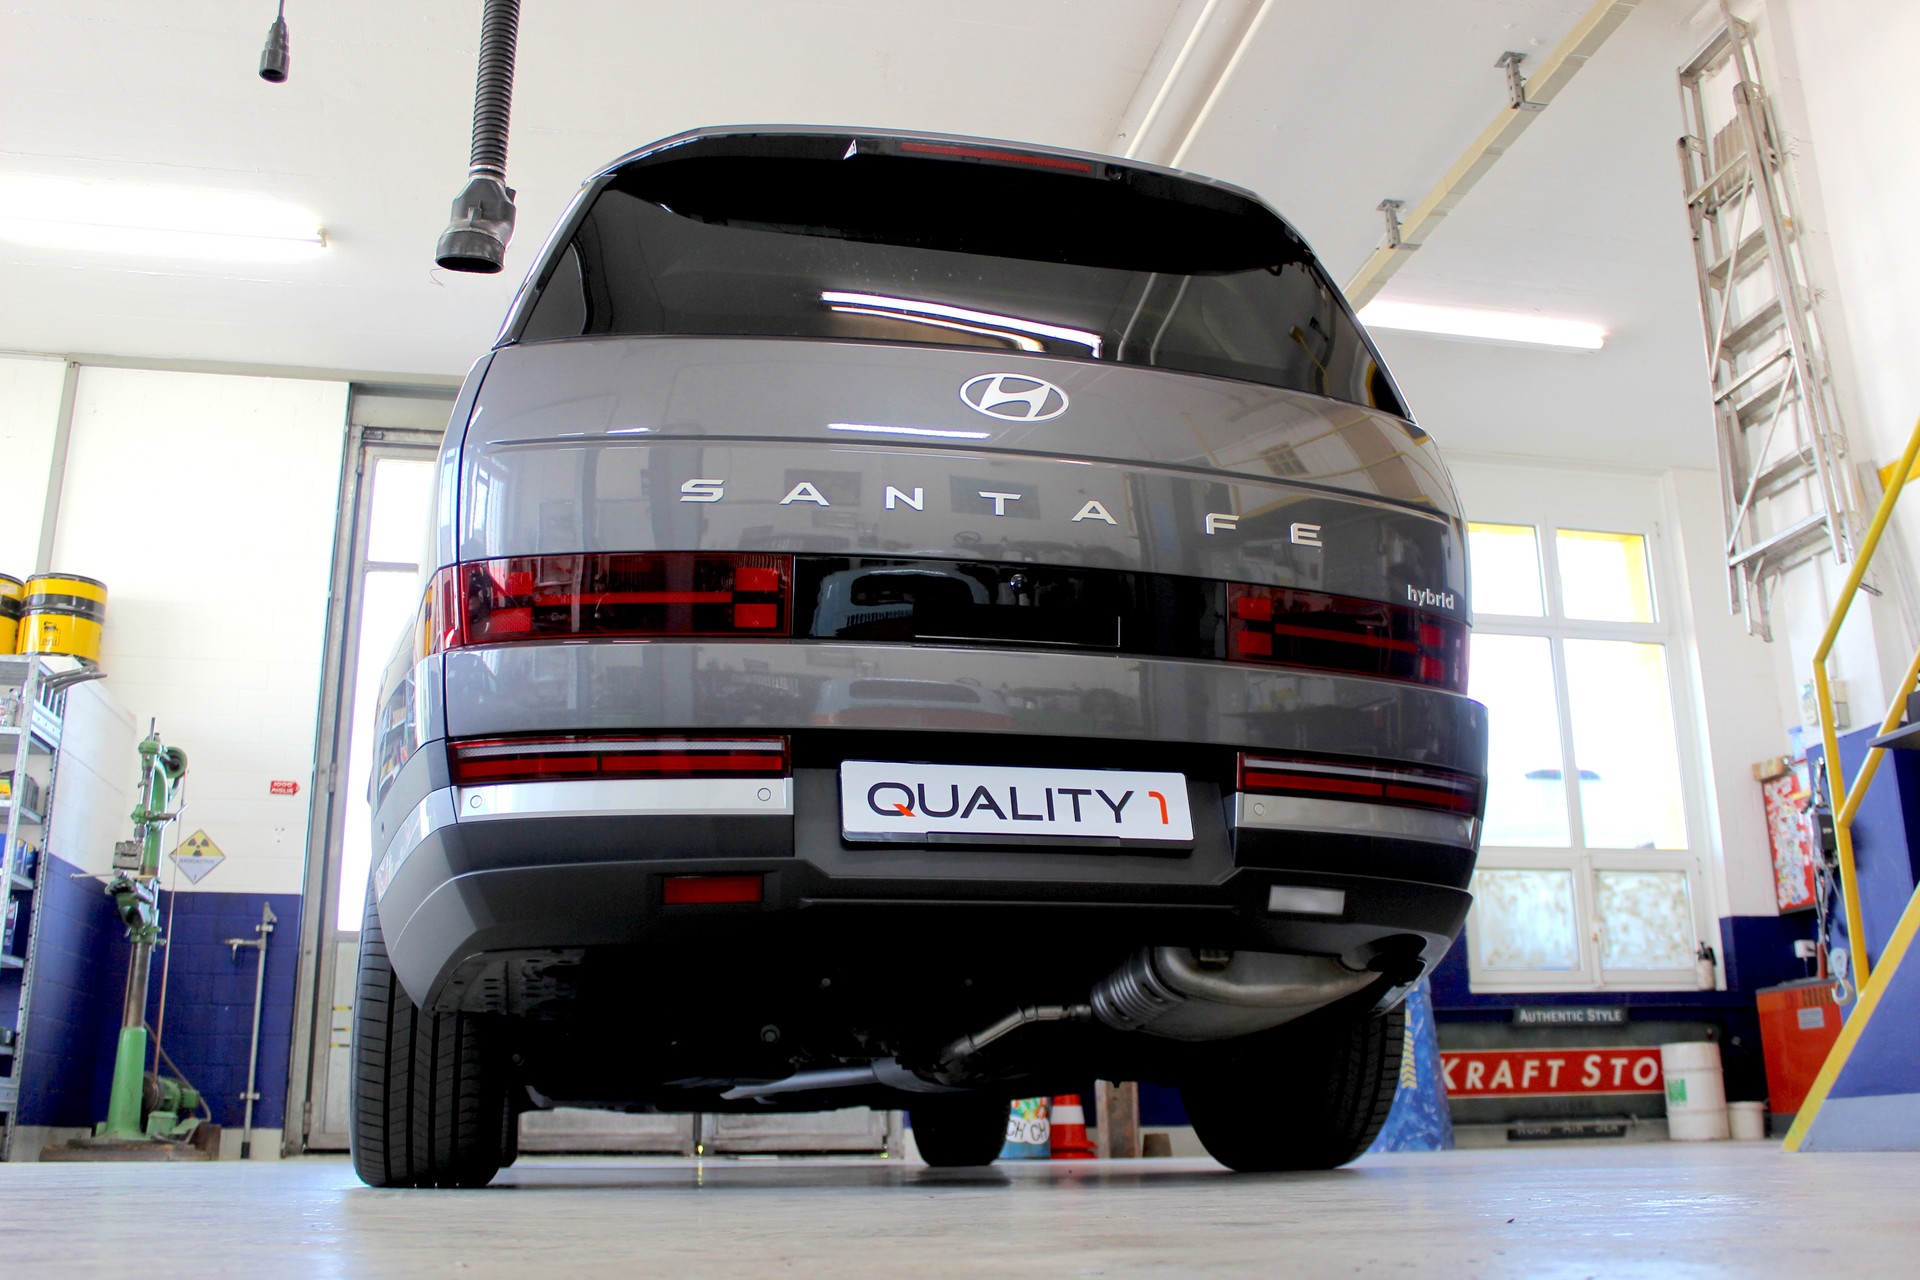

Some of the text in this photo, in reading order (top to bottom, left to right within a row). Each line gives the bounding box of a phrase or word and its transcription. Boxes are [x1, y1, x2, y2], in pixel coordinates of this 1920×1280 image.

[680, 478, 1323, 547] SANTA FE
[1407, 585, 1455, 610] hybrid
[867, 782, 1169, 825] QUALITY 1
[1520, 1007, 1622, 1023] AUTHENTIC STYLE
[1440, 1057, 1566, 1090] KRAFT
